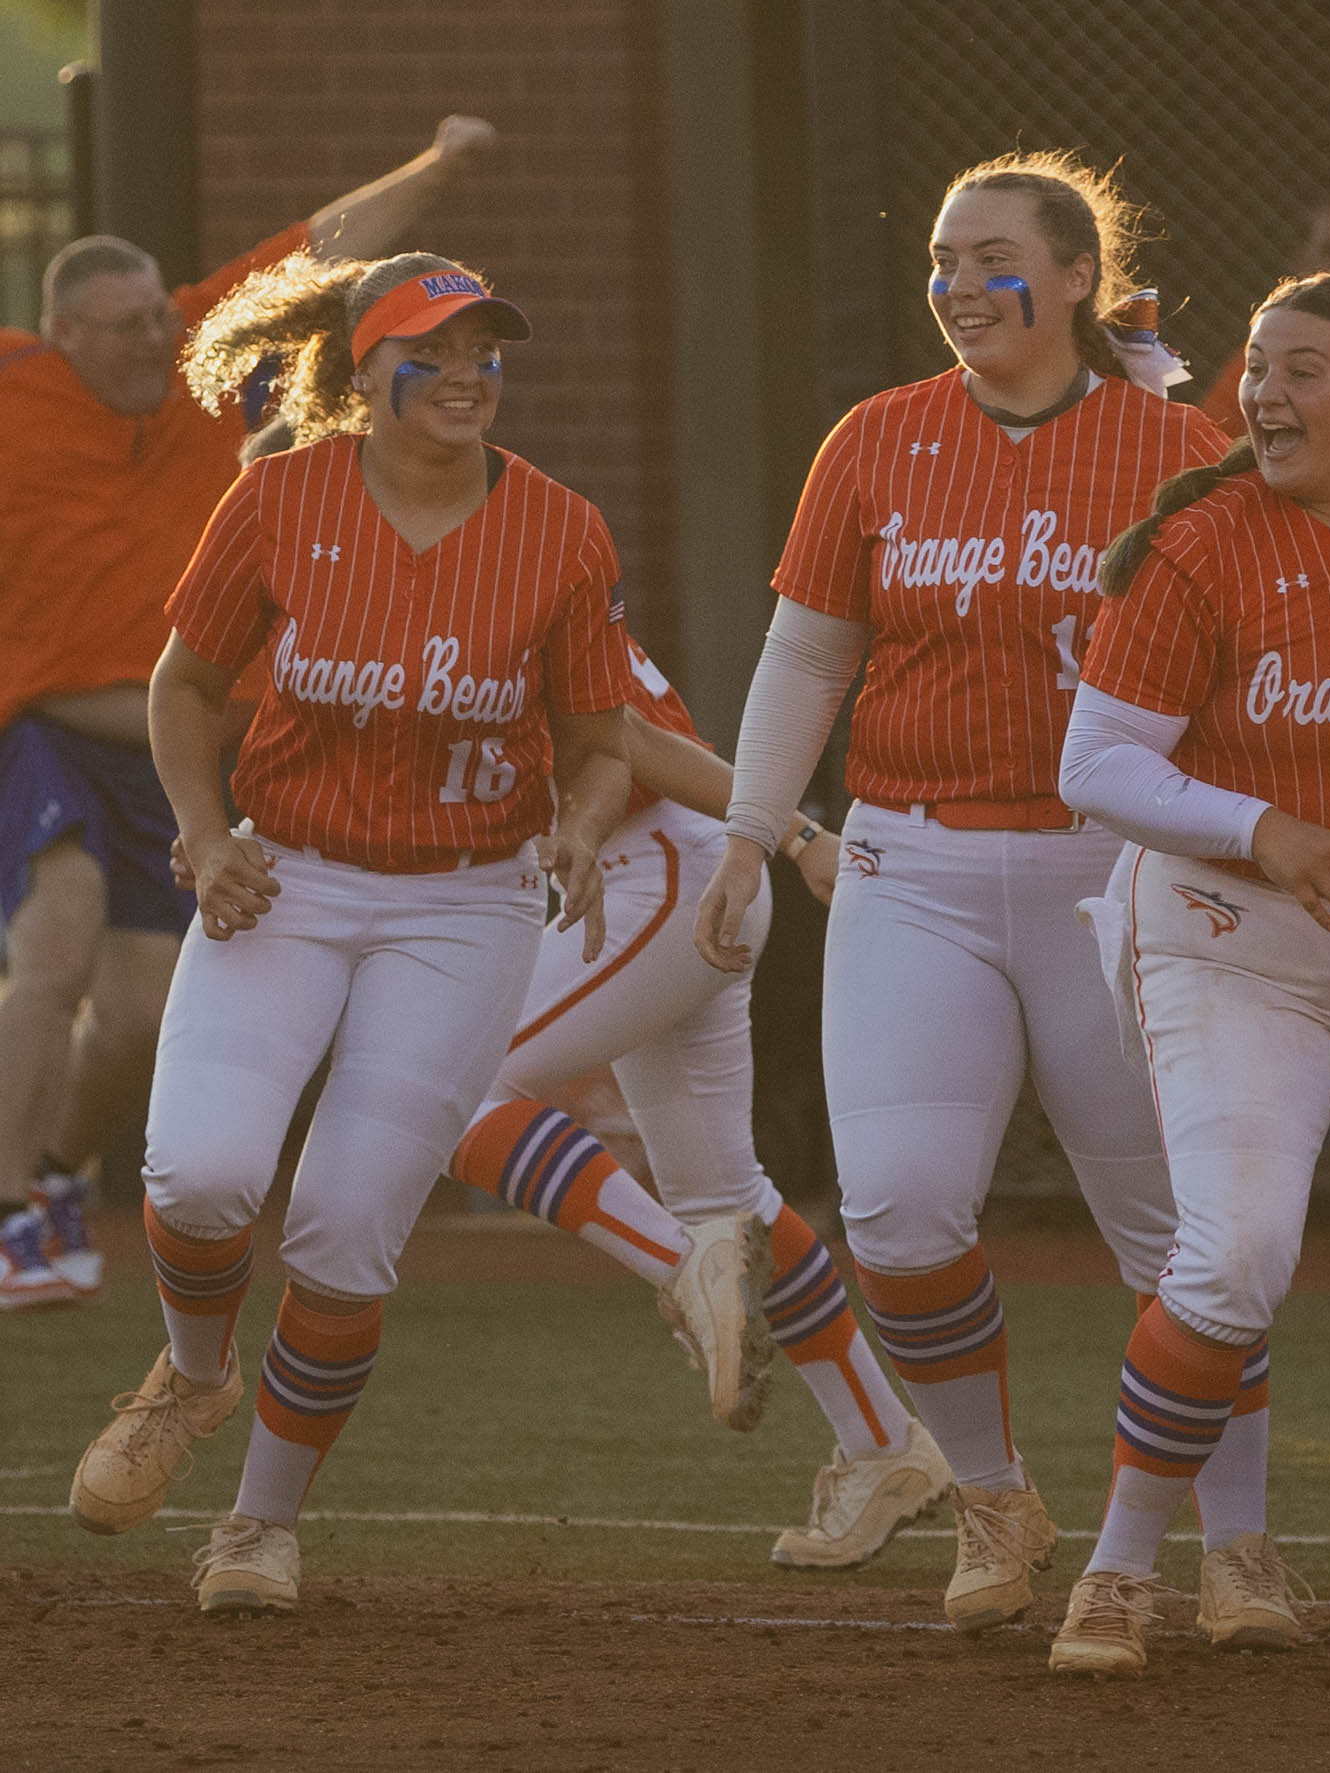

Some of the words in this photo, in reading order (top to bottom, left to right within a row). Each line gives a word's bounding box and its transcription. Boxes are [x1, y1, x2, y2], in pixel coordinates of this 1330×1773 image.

[879, 511, 1006, 618] Orange
[273, 616, 406, 728] Orange
[1052, 614, 1096, 690] 1
[439, 736, 517, 804] 16
